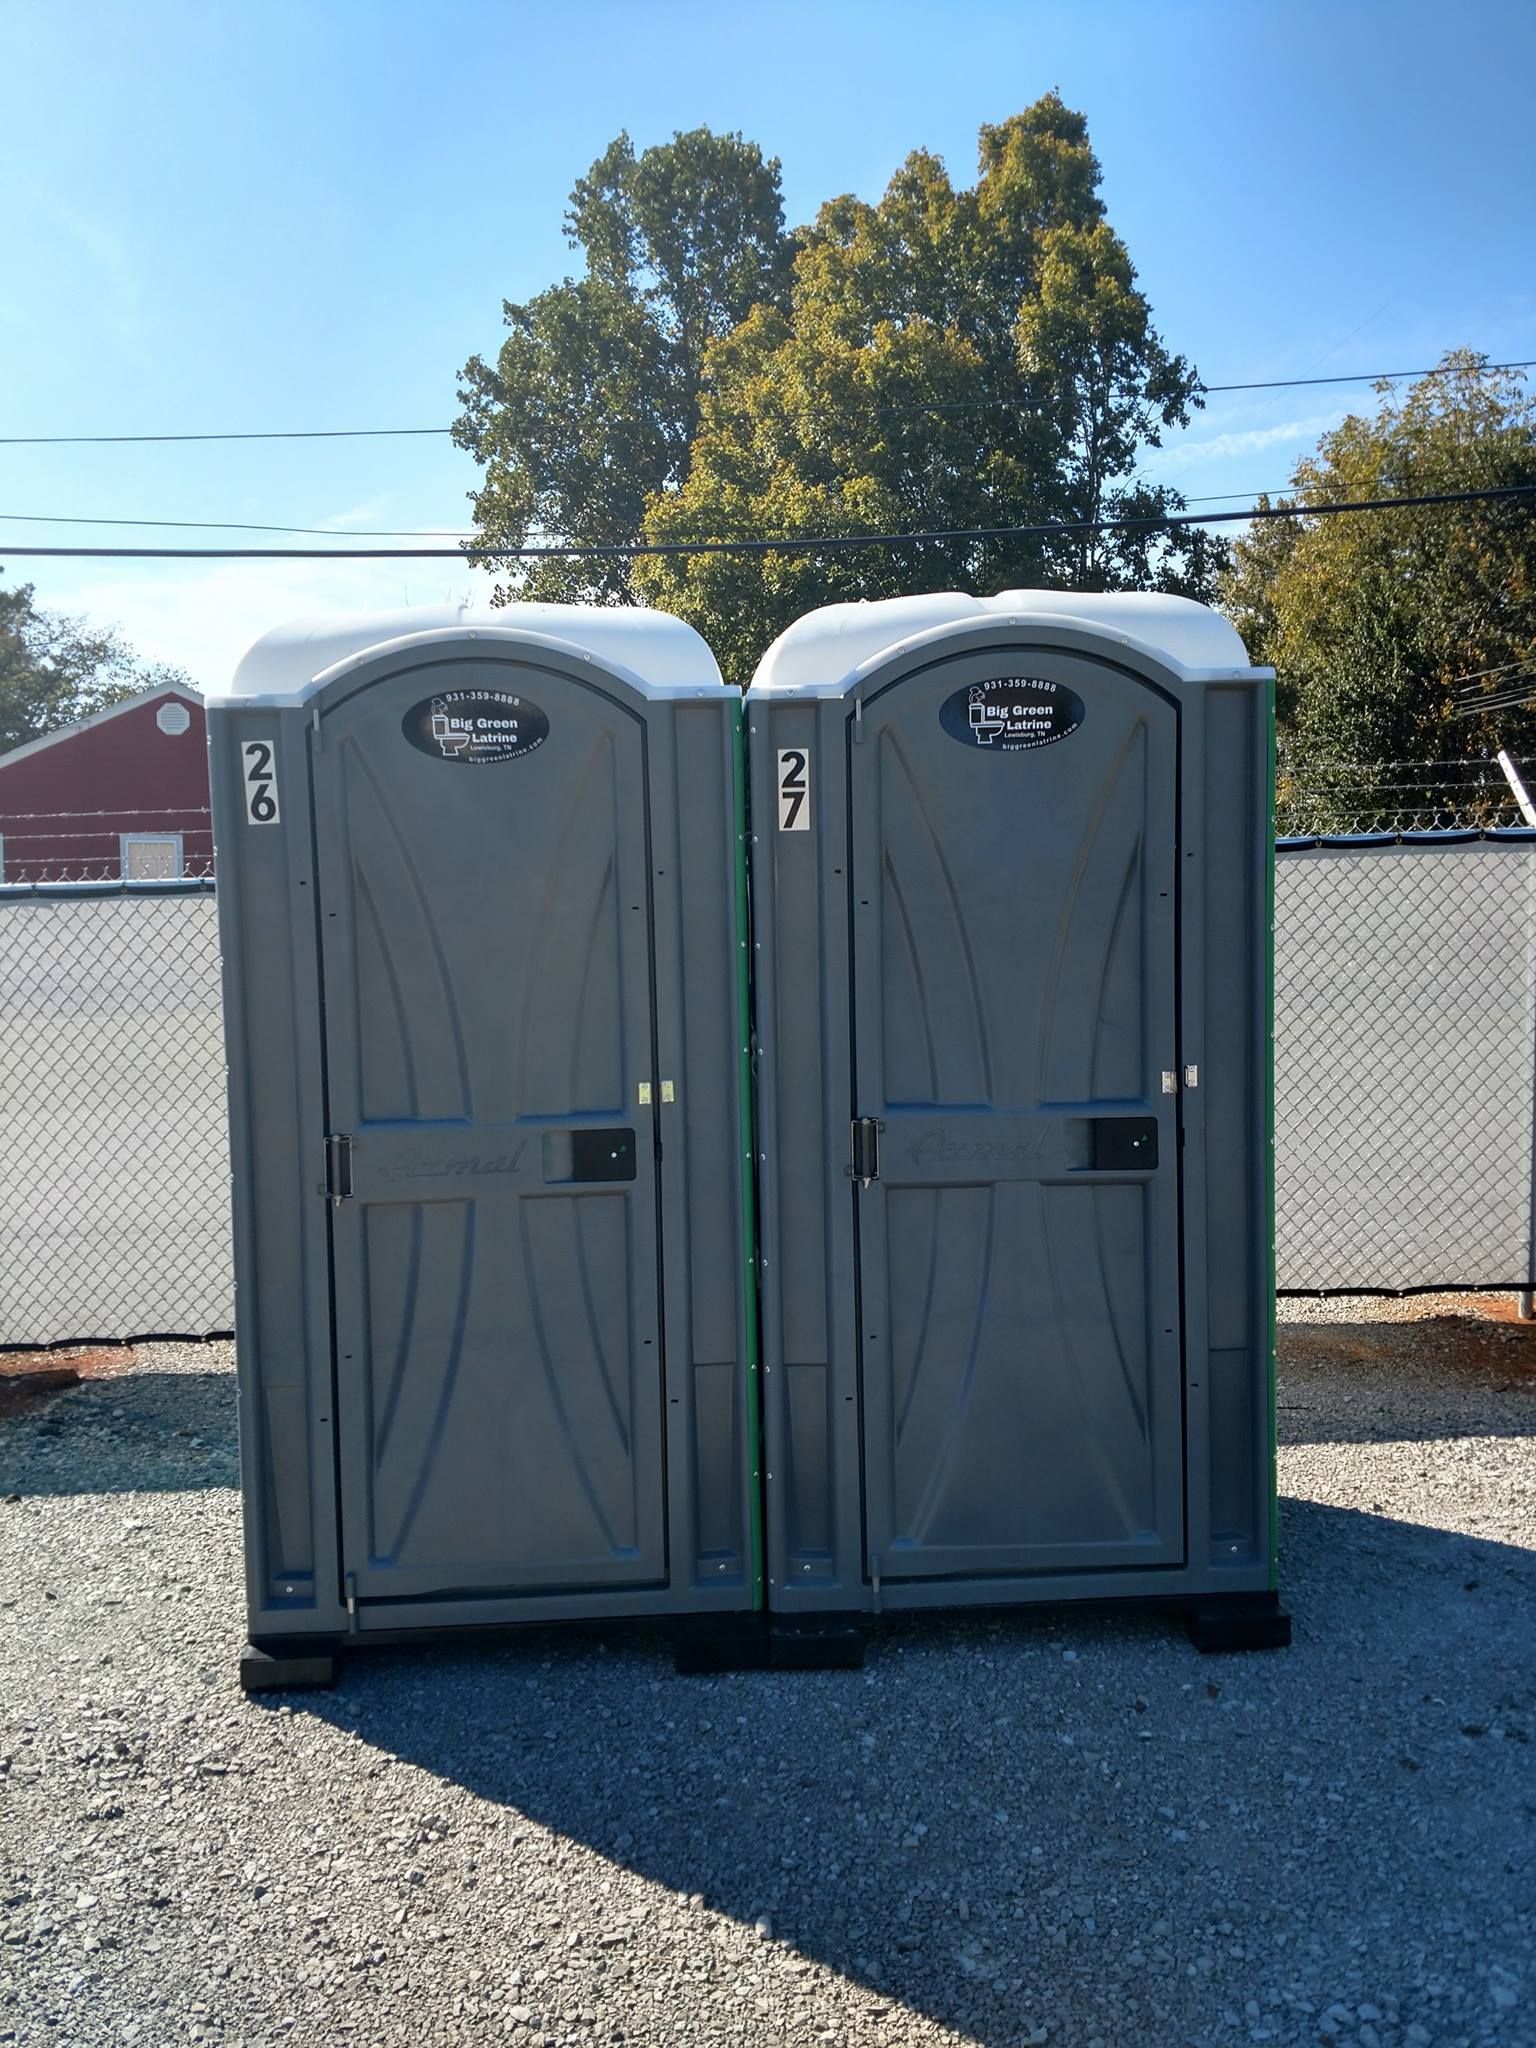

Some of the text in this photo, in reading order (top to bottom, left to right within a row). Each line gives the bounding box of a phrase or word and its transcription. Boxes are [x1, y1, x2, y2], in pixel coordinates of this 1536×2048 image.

[984, 679, 1056, 692] 931-359-8888
[446, 691, 520, 706] 931-359-8888
[987, 705, 1053, 719] Big Green
[450, 718, 518, 731] Big Green
[1007, 720, 1052, 730] Latrine
[472, 733, 517, 743] Latrine
[1002, 723, 1078, 750] biggreenlatrine.com
[468, 737, 543, 764] biggreenlatrine.com
